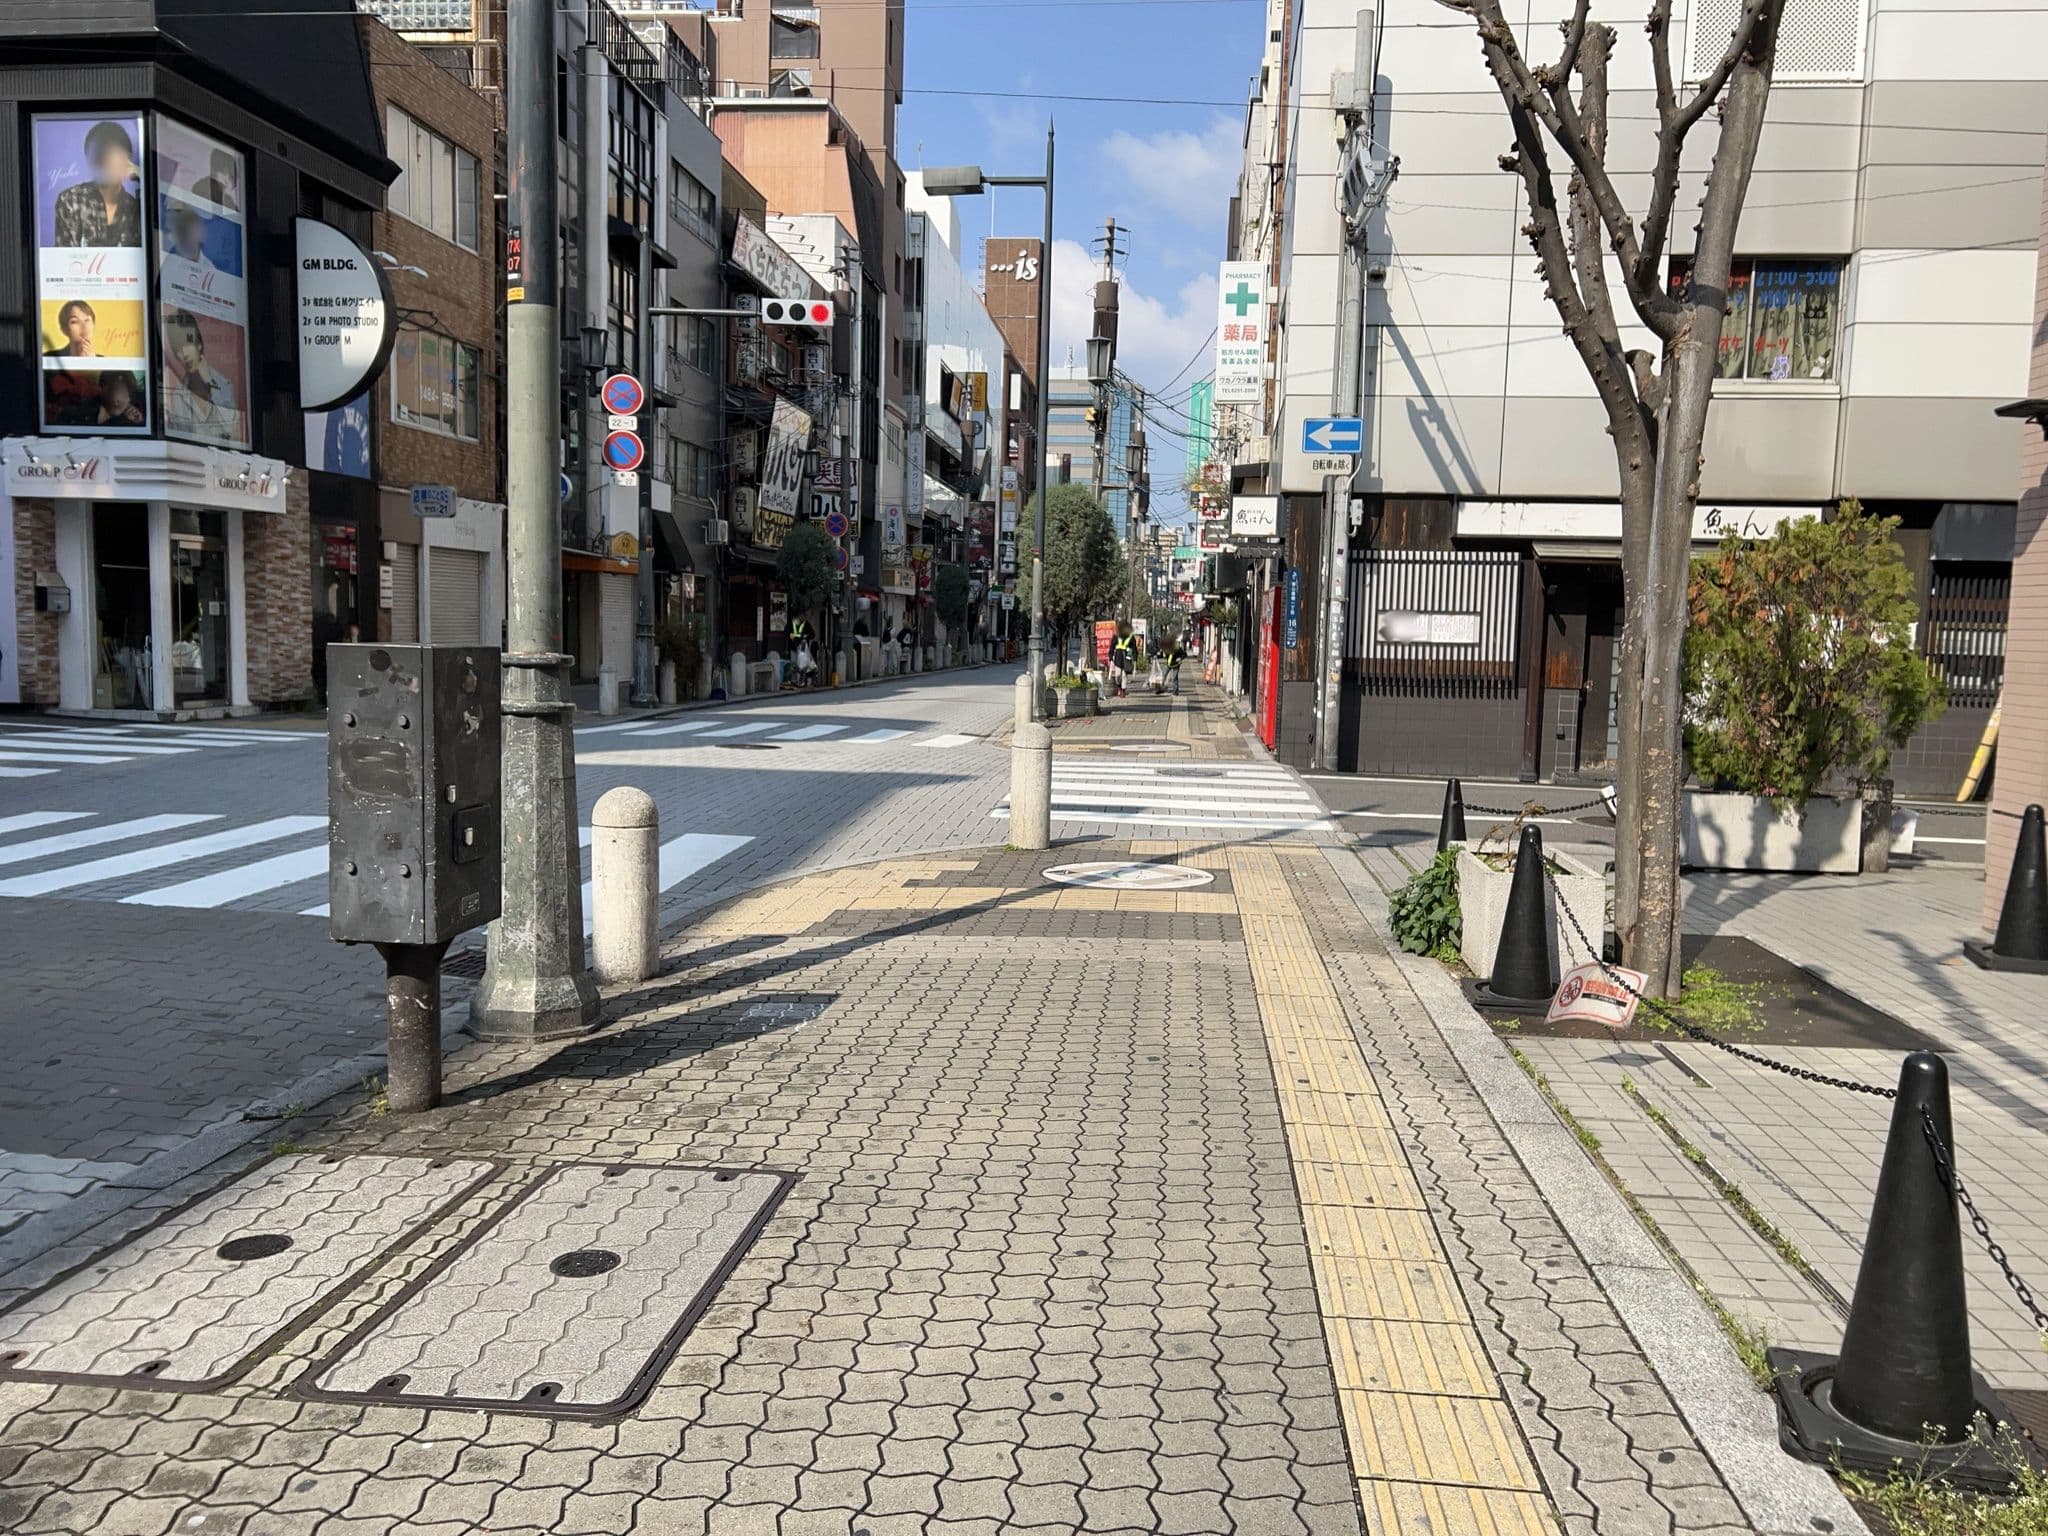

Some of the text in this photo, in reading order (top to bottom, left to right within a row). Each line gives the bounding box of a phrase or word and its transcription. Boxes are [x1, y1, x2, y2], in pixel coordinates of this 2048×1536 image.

[303, 259, 357, 271] GM BLDG.
[314, 317, 326, 326] GM
[329, 317, 351, 326] PHOTO
[354, 318, 378, 327] STUDIO
[1224, 324, 1258, 342] 薬局
[314, 336, 340, 346] GROUP
[344, 336, 351, 345] M
[1312, 459, 1350, 470] 自転車を除く
[18, 465, 61, 478] GROUP
[219, 478, 248, 491] GROUP
